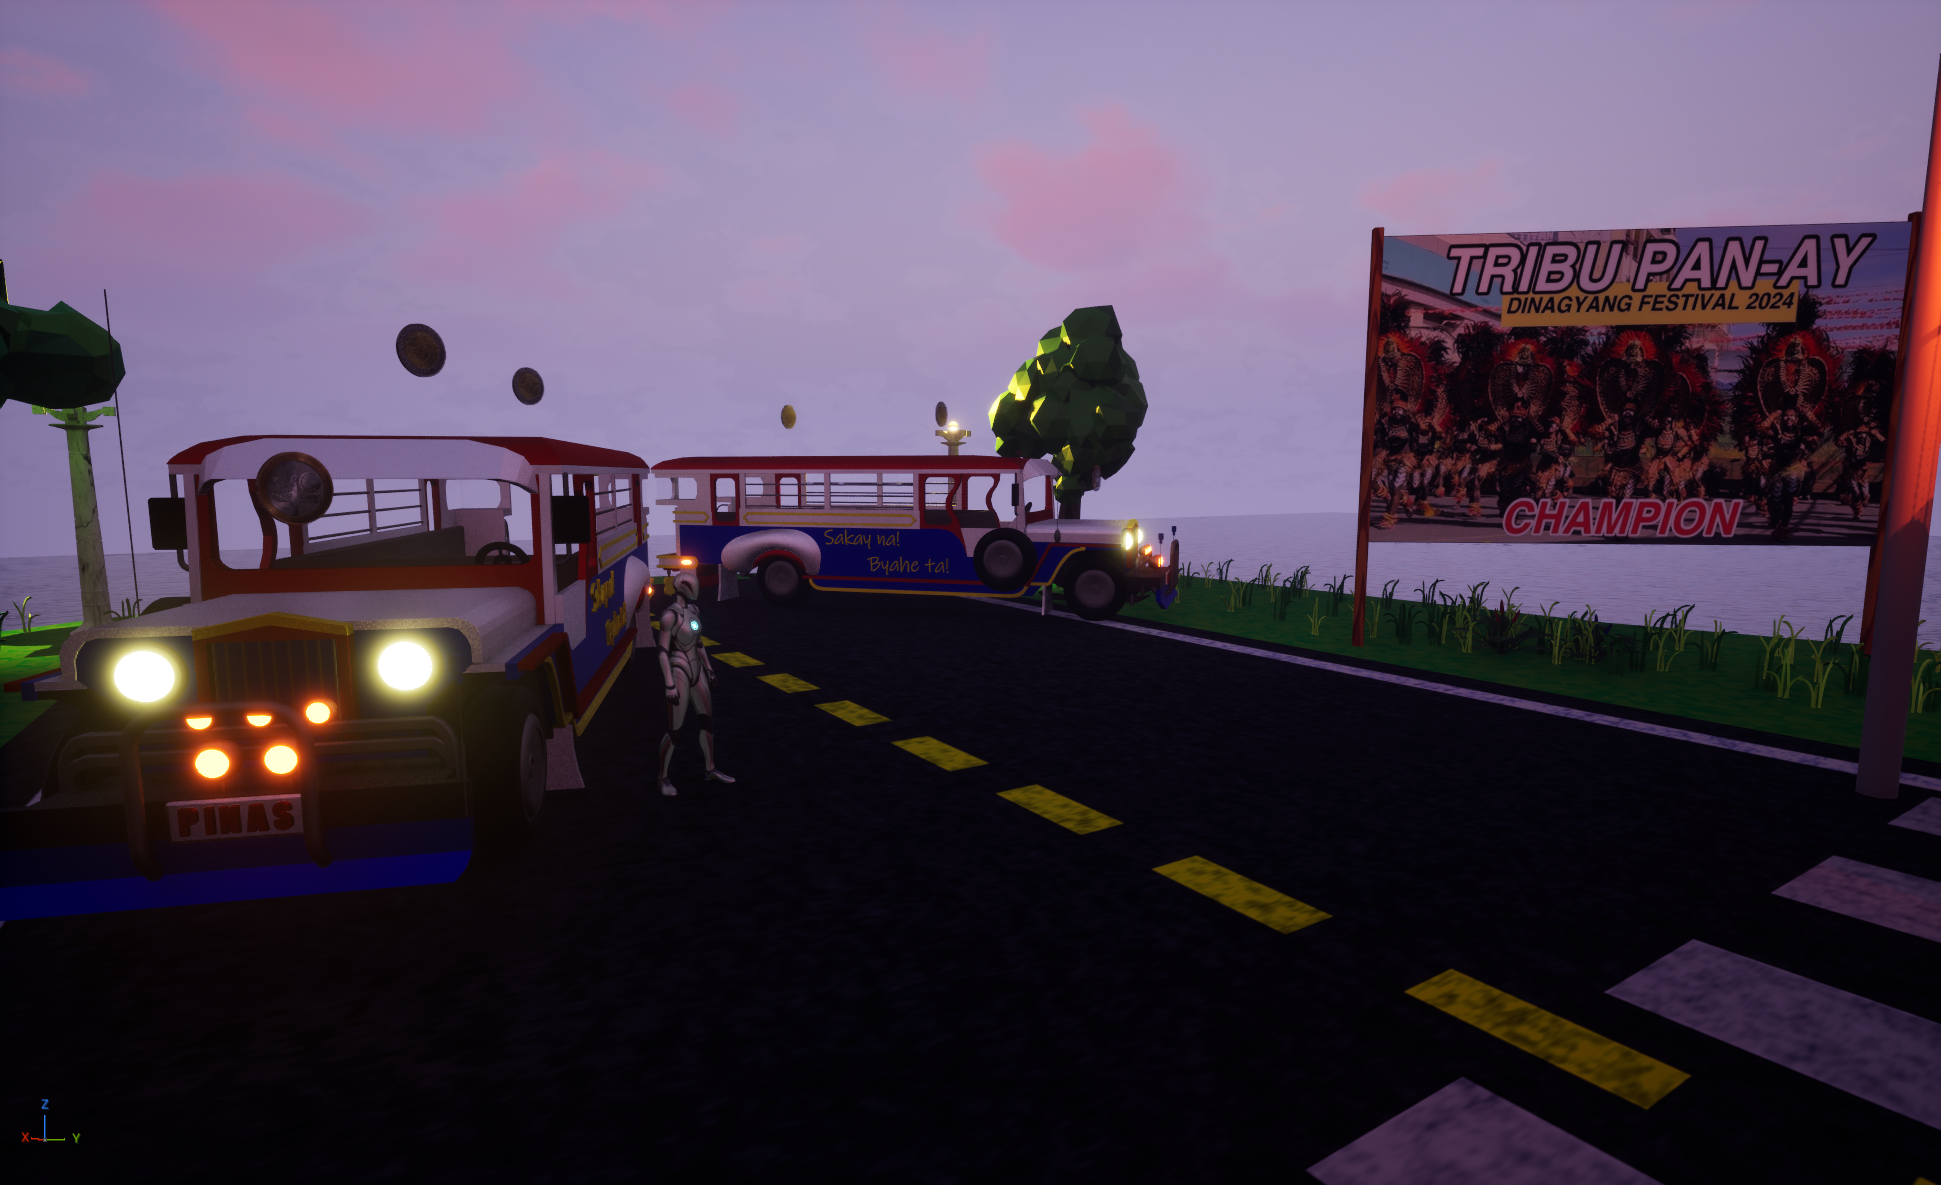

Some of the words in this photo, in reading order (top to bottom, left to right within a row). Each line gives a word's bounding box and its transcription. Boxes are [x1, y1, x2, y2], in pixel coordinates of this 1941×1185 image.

[1447, 240, 1626, 296] TRIBU
[1631, 232, 1878, 292] PAN-AY
[1506, 294, 1634, 315] DINAGYANG
[1637, 292, 1740, 312] FESTIVAL
[1745, 291, 1796, 310] 2024
[1502, 497, 1744, 538] CHAMPION
[823, 529, 872, 549] Sakay
[877, 530, 900, 546] na!
[866, 556, 920, 575] Byahe
[924, 557, 950, 573] ta!
[176, 800, 295, 838] PINAS
